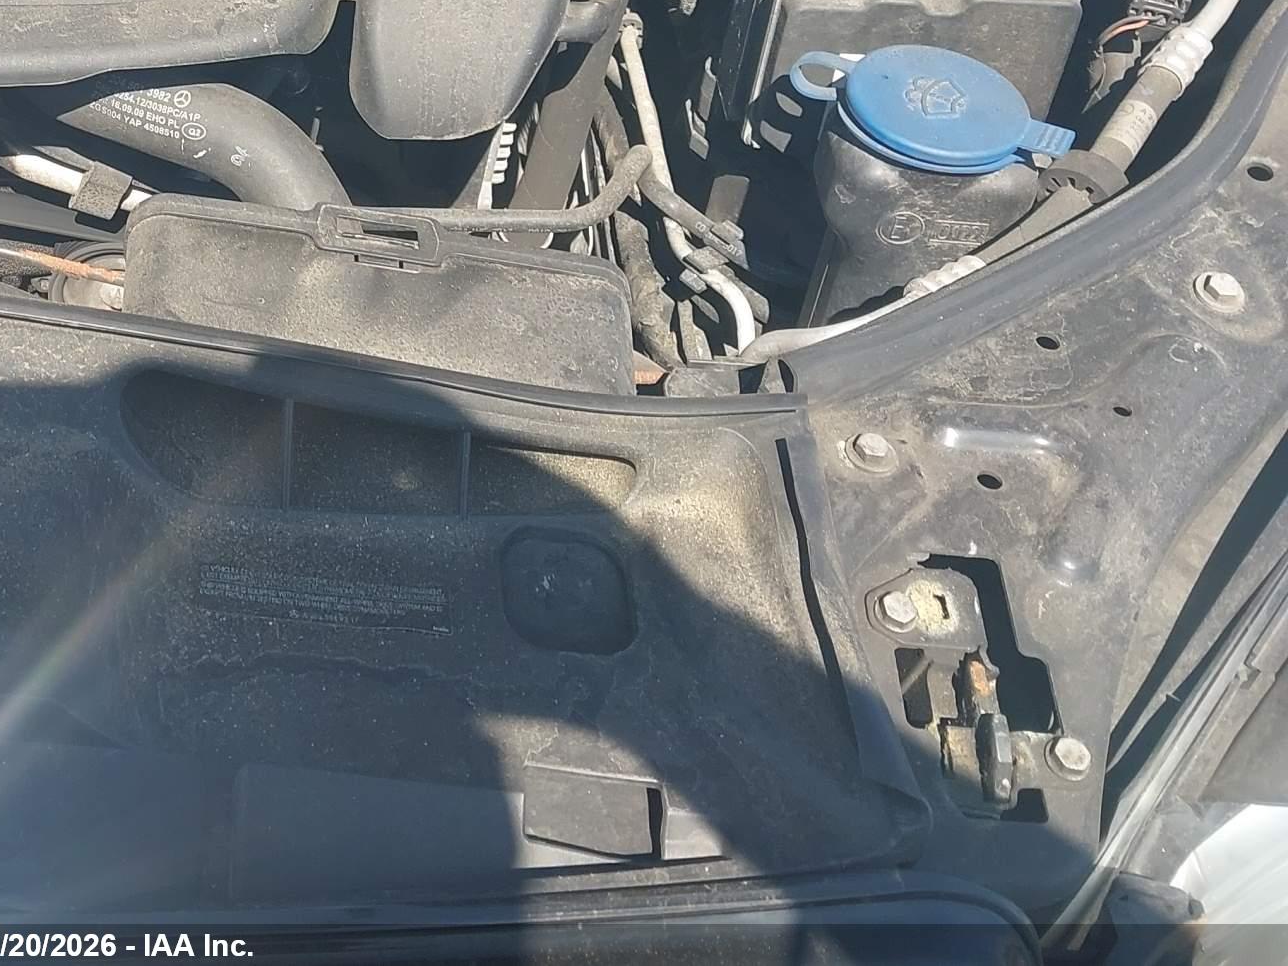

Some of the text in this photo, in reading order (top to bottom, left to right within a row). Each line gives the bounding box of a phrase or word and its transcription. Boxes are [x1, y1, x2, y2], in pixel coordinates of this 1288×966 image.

[147, 88, 171, 102] 3982
[124, 117, 142, 128] YAP
[167, 118, 180, 129] PL
